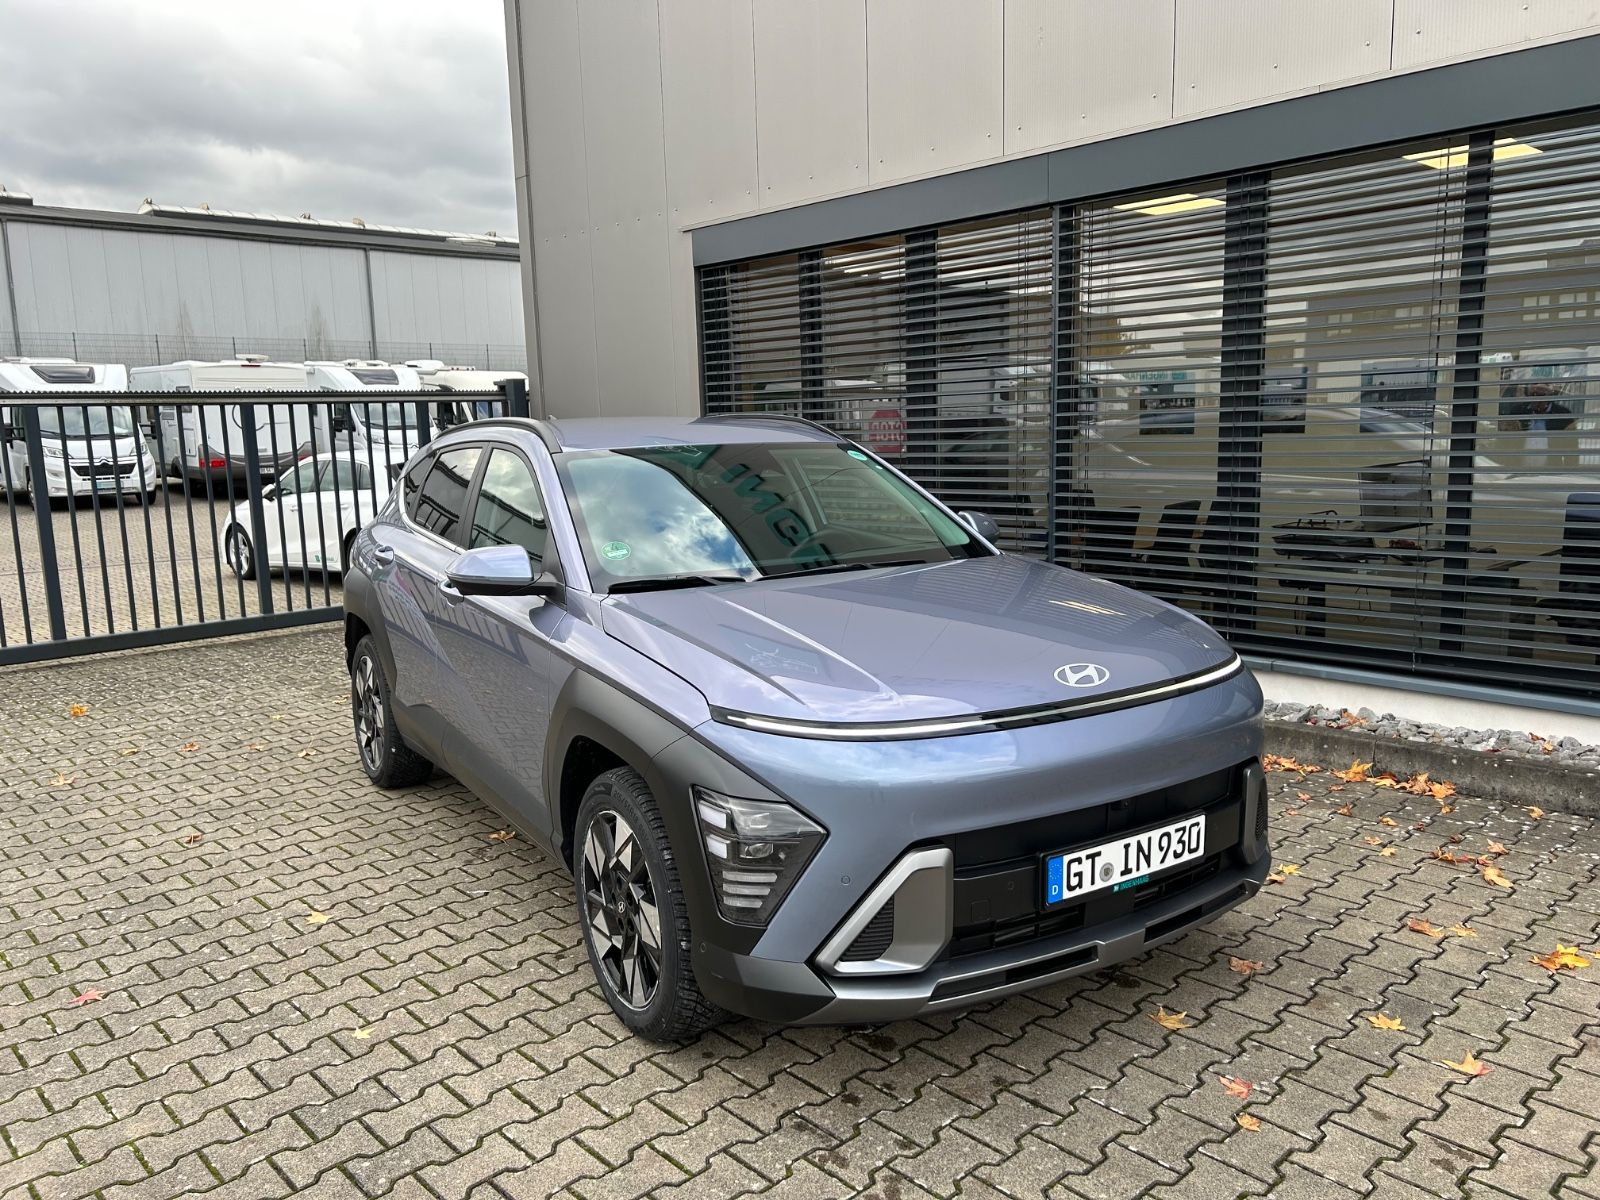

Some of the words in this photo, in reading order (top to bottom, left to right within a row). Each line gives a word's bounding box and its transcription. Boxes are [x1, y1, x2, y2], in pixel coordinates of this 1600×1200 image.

[1066, 851, 1102, 892] GT
[1120, 836, 1151, 877] IN
[1158, 821, 1201, 864] 930
[1051, 884, 1059, 896] D
